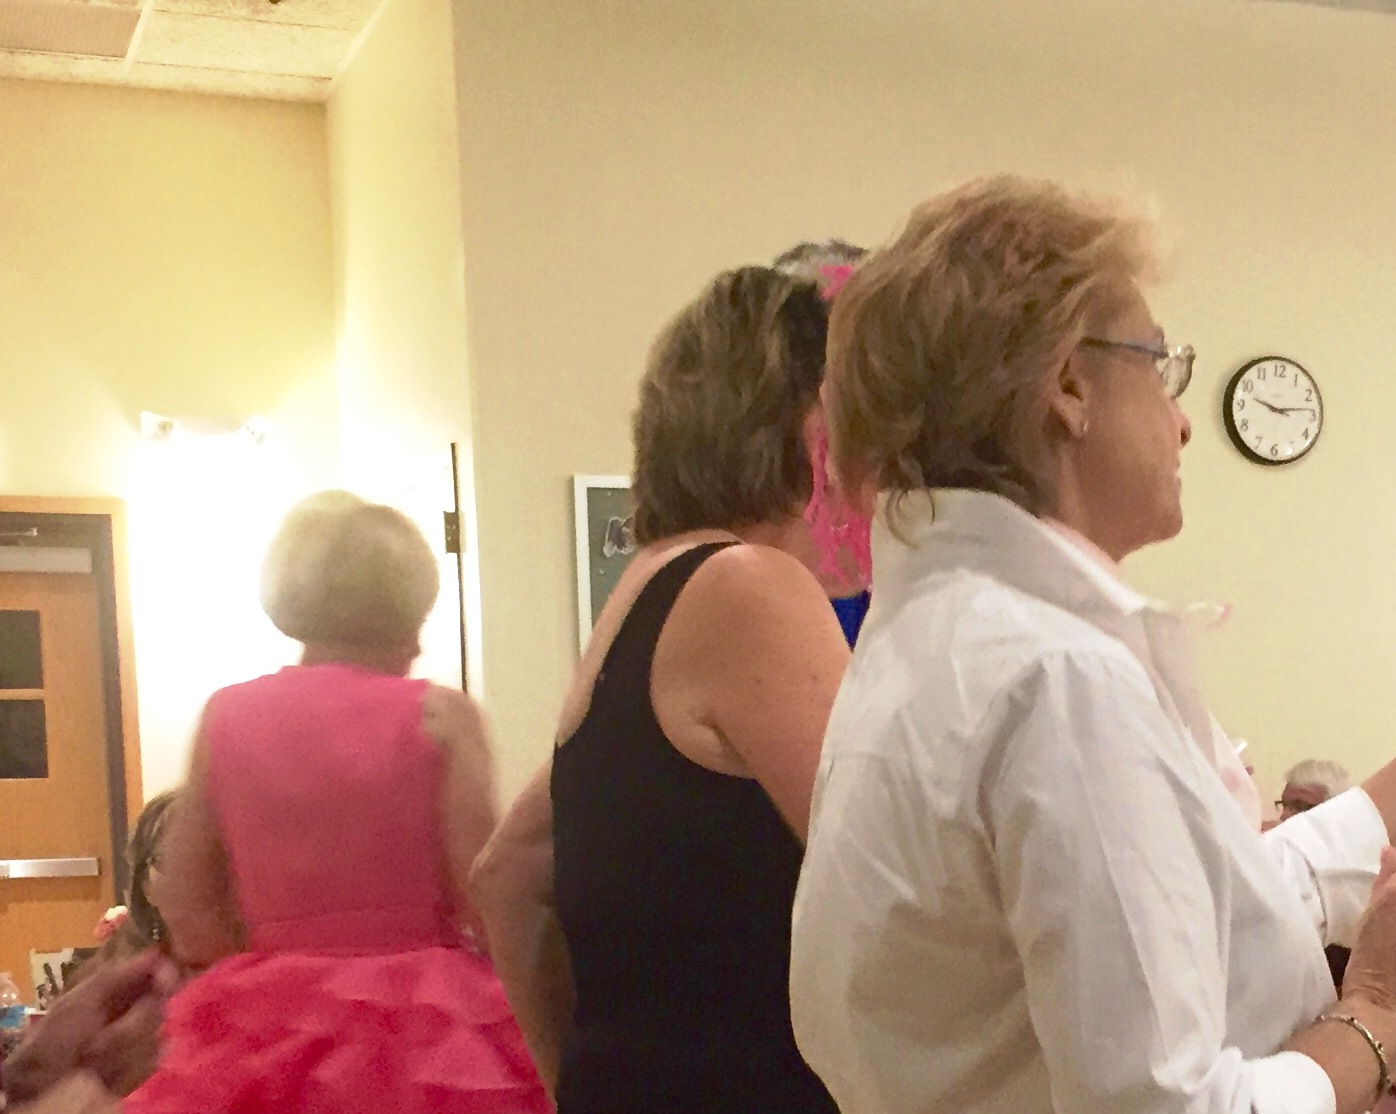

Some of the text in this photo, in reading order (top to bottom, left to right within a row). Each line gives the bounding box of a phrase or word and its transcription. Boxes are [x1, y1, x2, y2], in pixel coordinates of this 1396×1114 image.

[1257, 367, 1266, 380] 11
[1274, 365, 1286, 378] 12
[1242, 379, 1254, 393] 10
[1294, 373, 1298, 387] 1
[1305, 389, 1313, 402] 2
[1237, 399, 1245, 411] 9
[1309, 408, 1316, 423] 3
[1240, 419, 1248, 432] 8
[1302, 428, 1309, 440] 4
[1255, 436, 1262, 449] 7
[1270, 444, 1278, 456] 6
